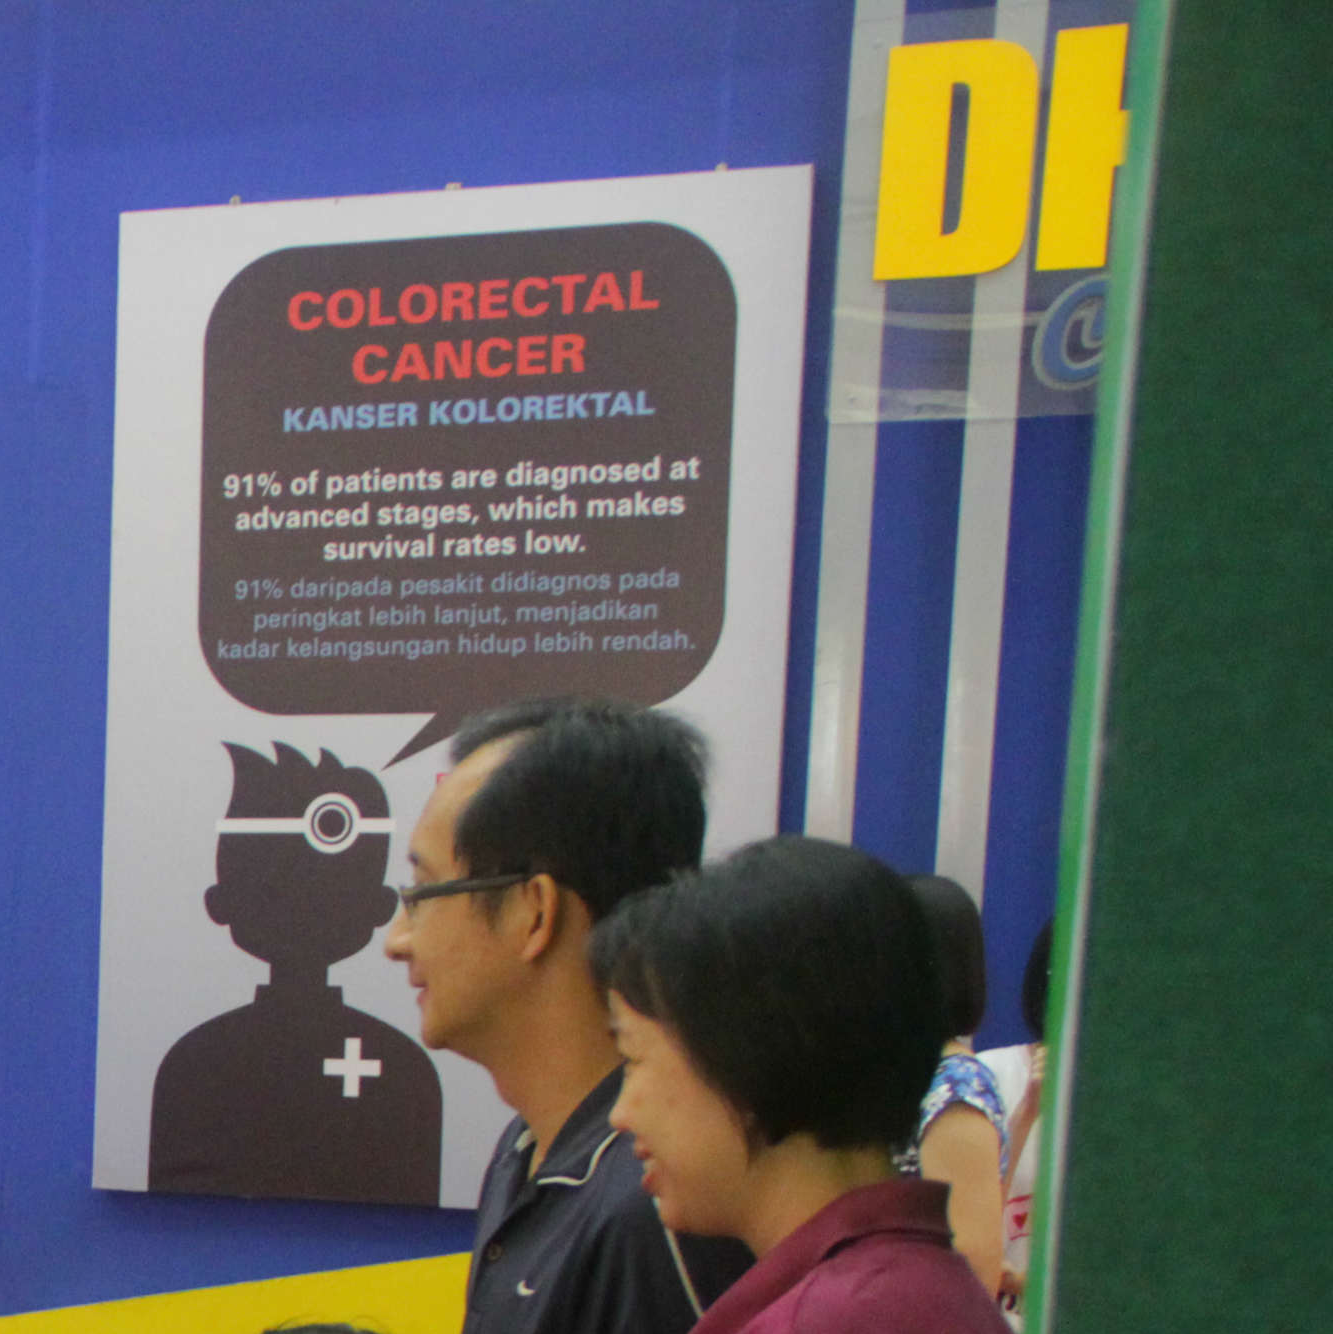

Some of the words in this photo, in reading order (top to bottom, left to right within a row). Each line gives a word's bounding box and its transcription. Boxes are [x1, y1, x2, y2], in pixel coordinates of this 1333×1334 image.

[287, 270, 661, 330] COLORECTAL
[352, 333, 587, 384] CANCER
[283, 402, 418, 433] KANSER
[429, 390, 655, 426] KOLOREKTAL
[224, 473, 282, 498] 91%
[291, 472, 319, 496] of
[326, 466, 443, 499] patients
[451, 468, 496, 489] are
[506, 457, 662, 492] diagnosed
[670, 456, 700, 481] at
[236, 503, 368, 531] advanced
[377, 500, 479, 532] stages,
[488, 496, 577, 524] which
[587, 492, 685, 518] makes
[323, 533, 434, 561] survival
[444, 533, 516, 557] rates
[525, 529, 586, 555] low.
[235, 578, 283, 600] 91%
[290, 577, 392, 603] daripada
[400, 573, 483, 601] pesakit
[491, 570, 612, 597] didiagnos
[618, 568, 679, 595] pada
[254, 605, 362, 633] peringkat
[369, 603, 426, 627] lebih
[434, 604, 507, 630] lanjut,
[517, 600, 657, 626] menjadikan
[218, 638, 278, 660] kadar
[287, 635, 449, 662] kelangsungan
[458, 633, 526, 657] hidup
[534, 631, 593, 654] lebih
[602, 630, 695, 653] rendah.
